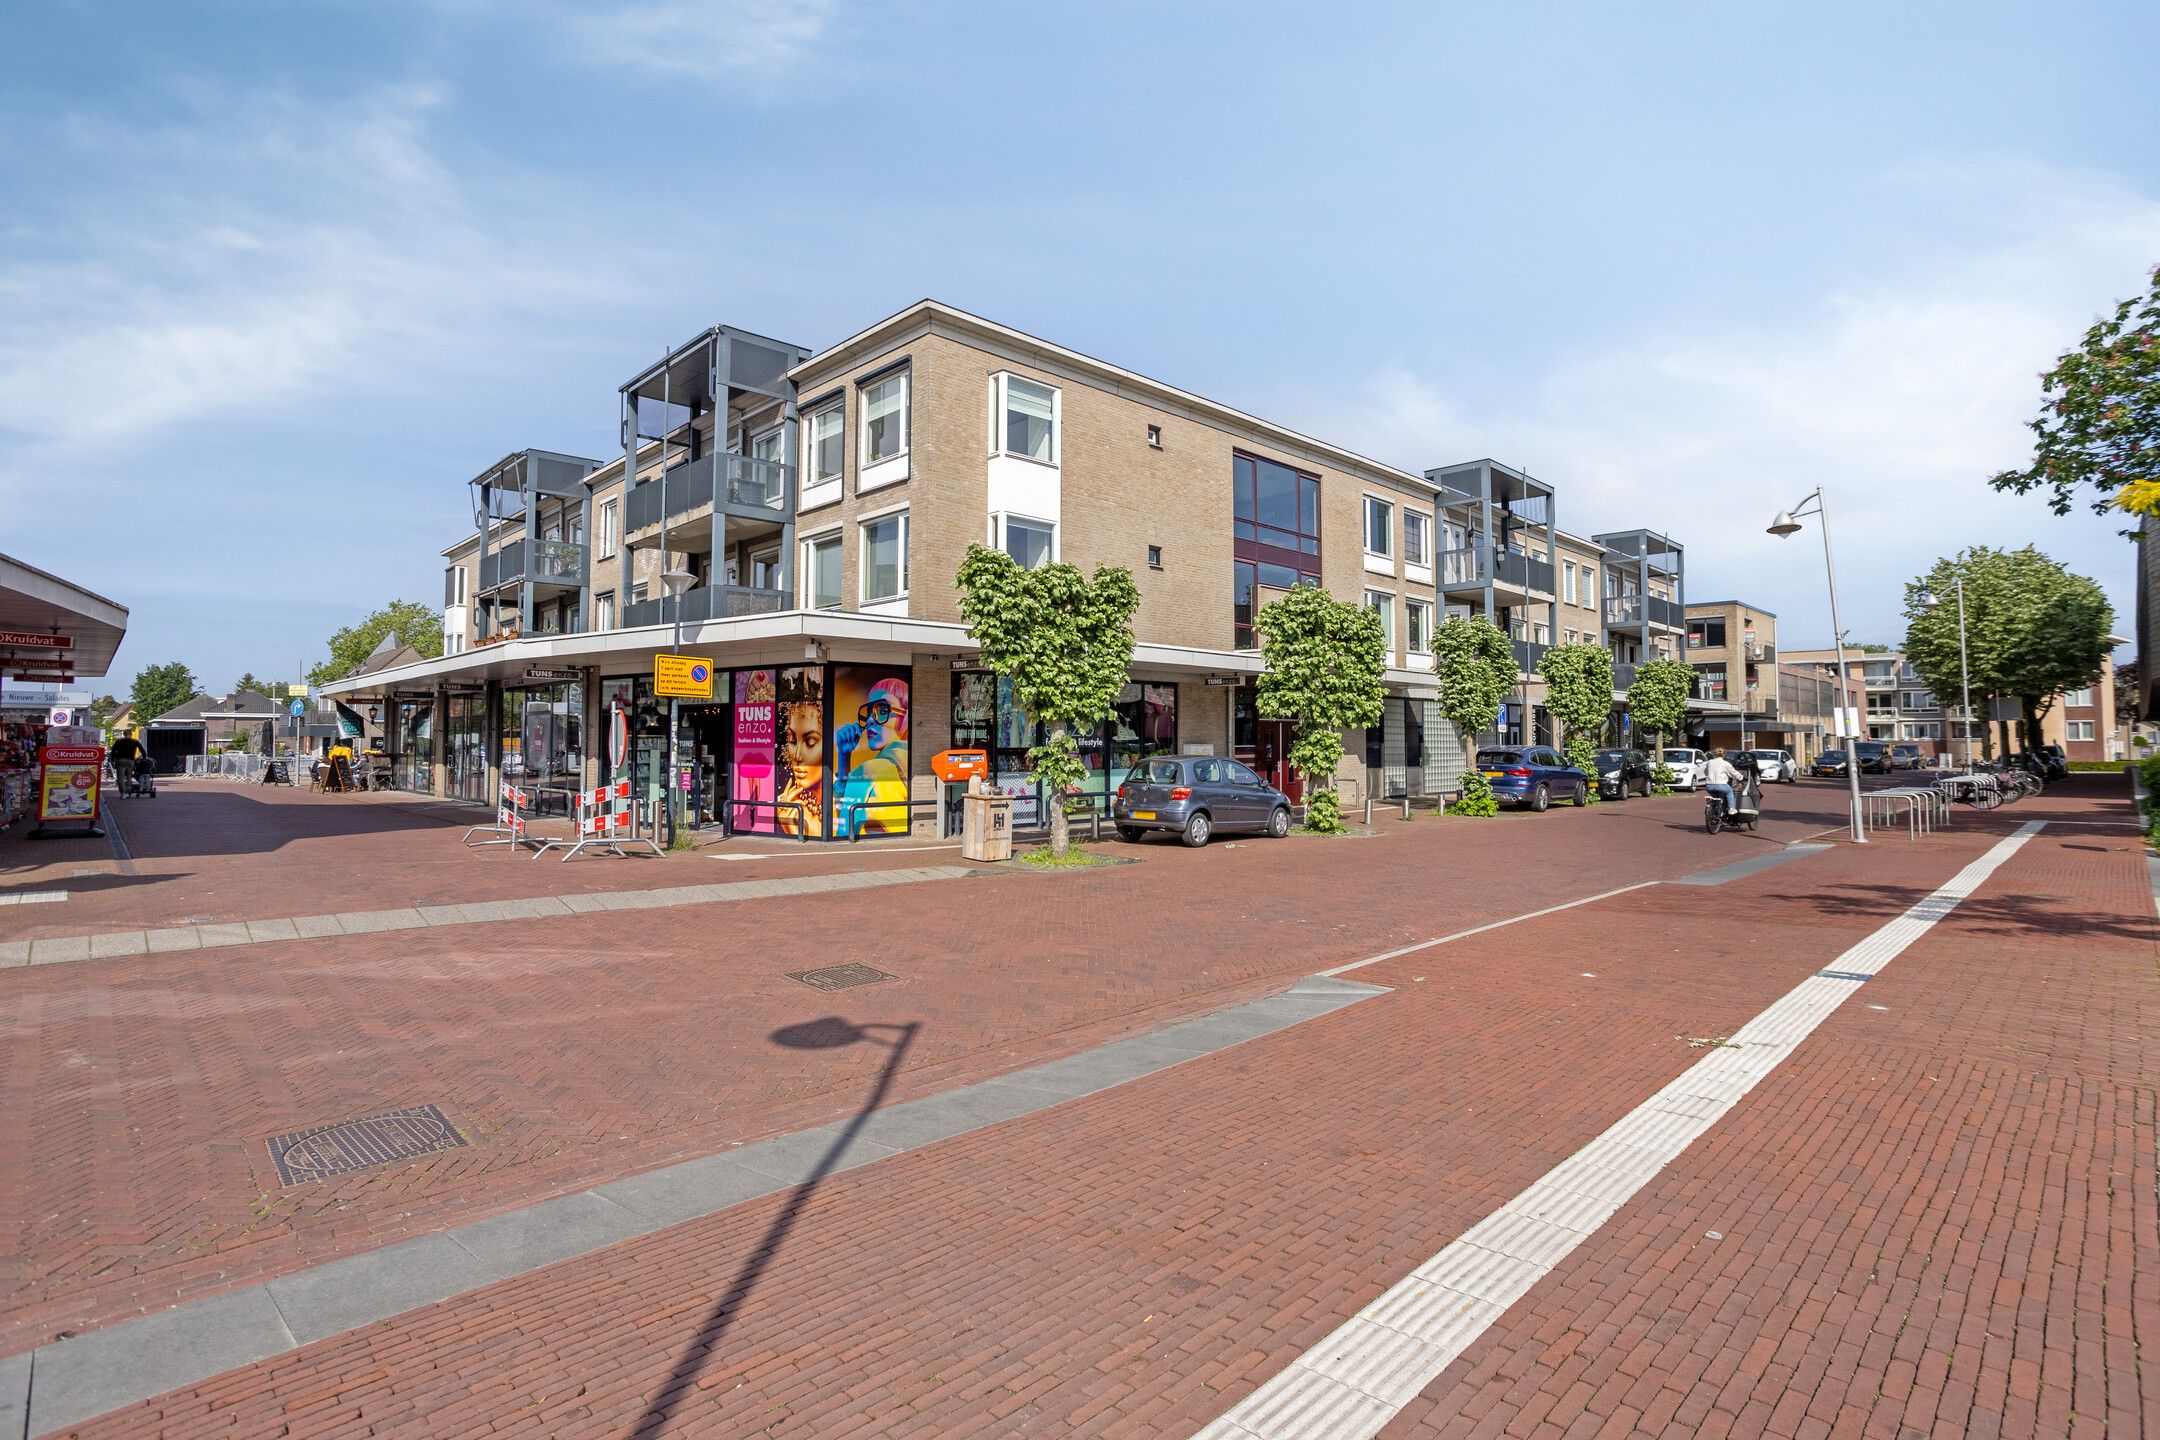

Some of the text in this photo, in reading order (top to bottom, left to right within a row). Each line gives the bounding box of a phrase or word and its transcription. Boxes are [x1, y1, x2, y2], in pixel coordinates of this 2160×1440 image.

[5, 634, 55, 646] Kruidvat
[22, 660, 61, 669] Kruidvat
[953, 660, 968, 669] TUNS
[45, 693, 70, 702] Salades
[738, 706, 772, 721] TUNS
[1078, 737, 1103, 748] lifestyle
